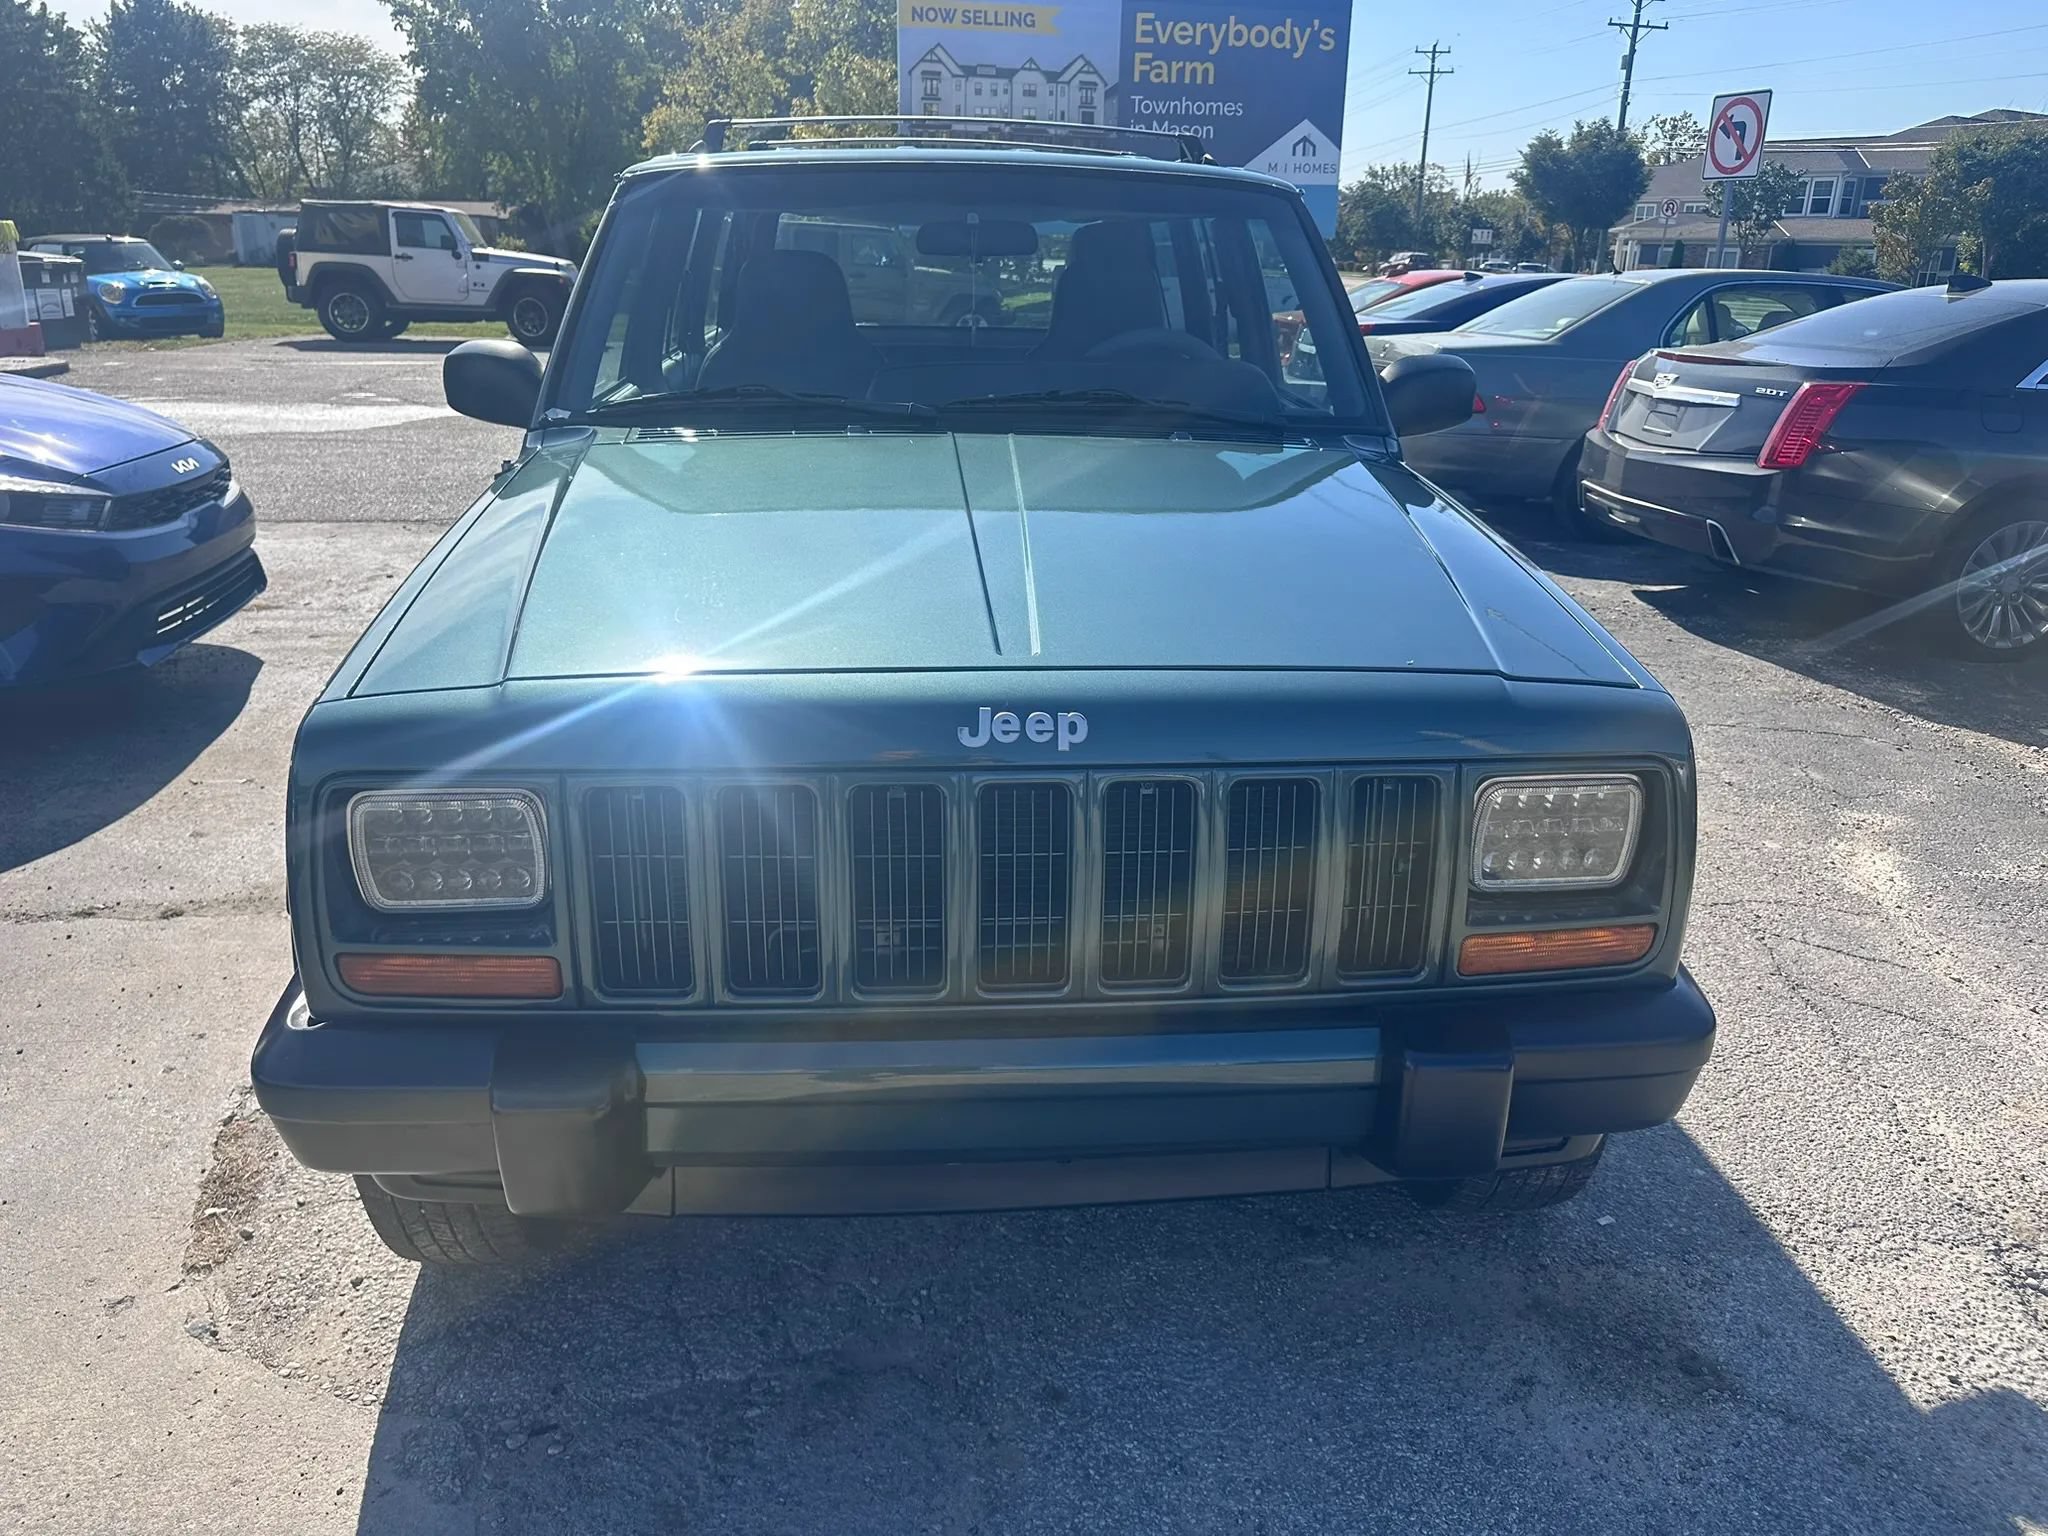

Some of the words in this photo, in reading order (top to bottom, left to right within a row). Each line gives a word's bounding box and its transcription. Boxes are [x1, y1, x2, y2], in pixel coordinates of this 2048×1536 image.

[911, 6, 957, 24] NOW
[961, 9, 1036, 28] SELLING
[1135, 12, 1336, 59] Everybody's
[1133, 52, 1215, 85] Farm
[1130, 95, 1243, 116] Townhomes
[1152, 120, 1214, 139] Mason
[1293, 162, 1337, 174] HOMES
[957, 706, 1089, 751] Jeep
